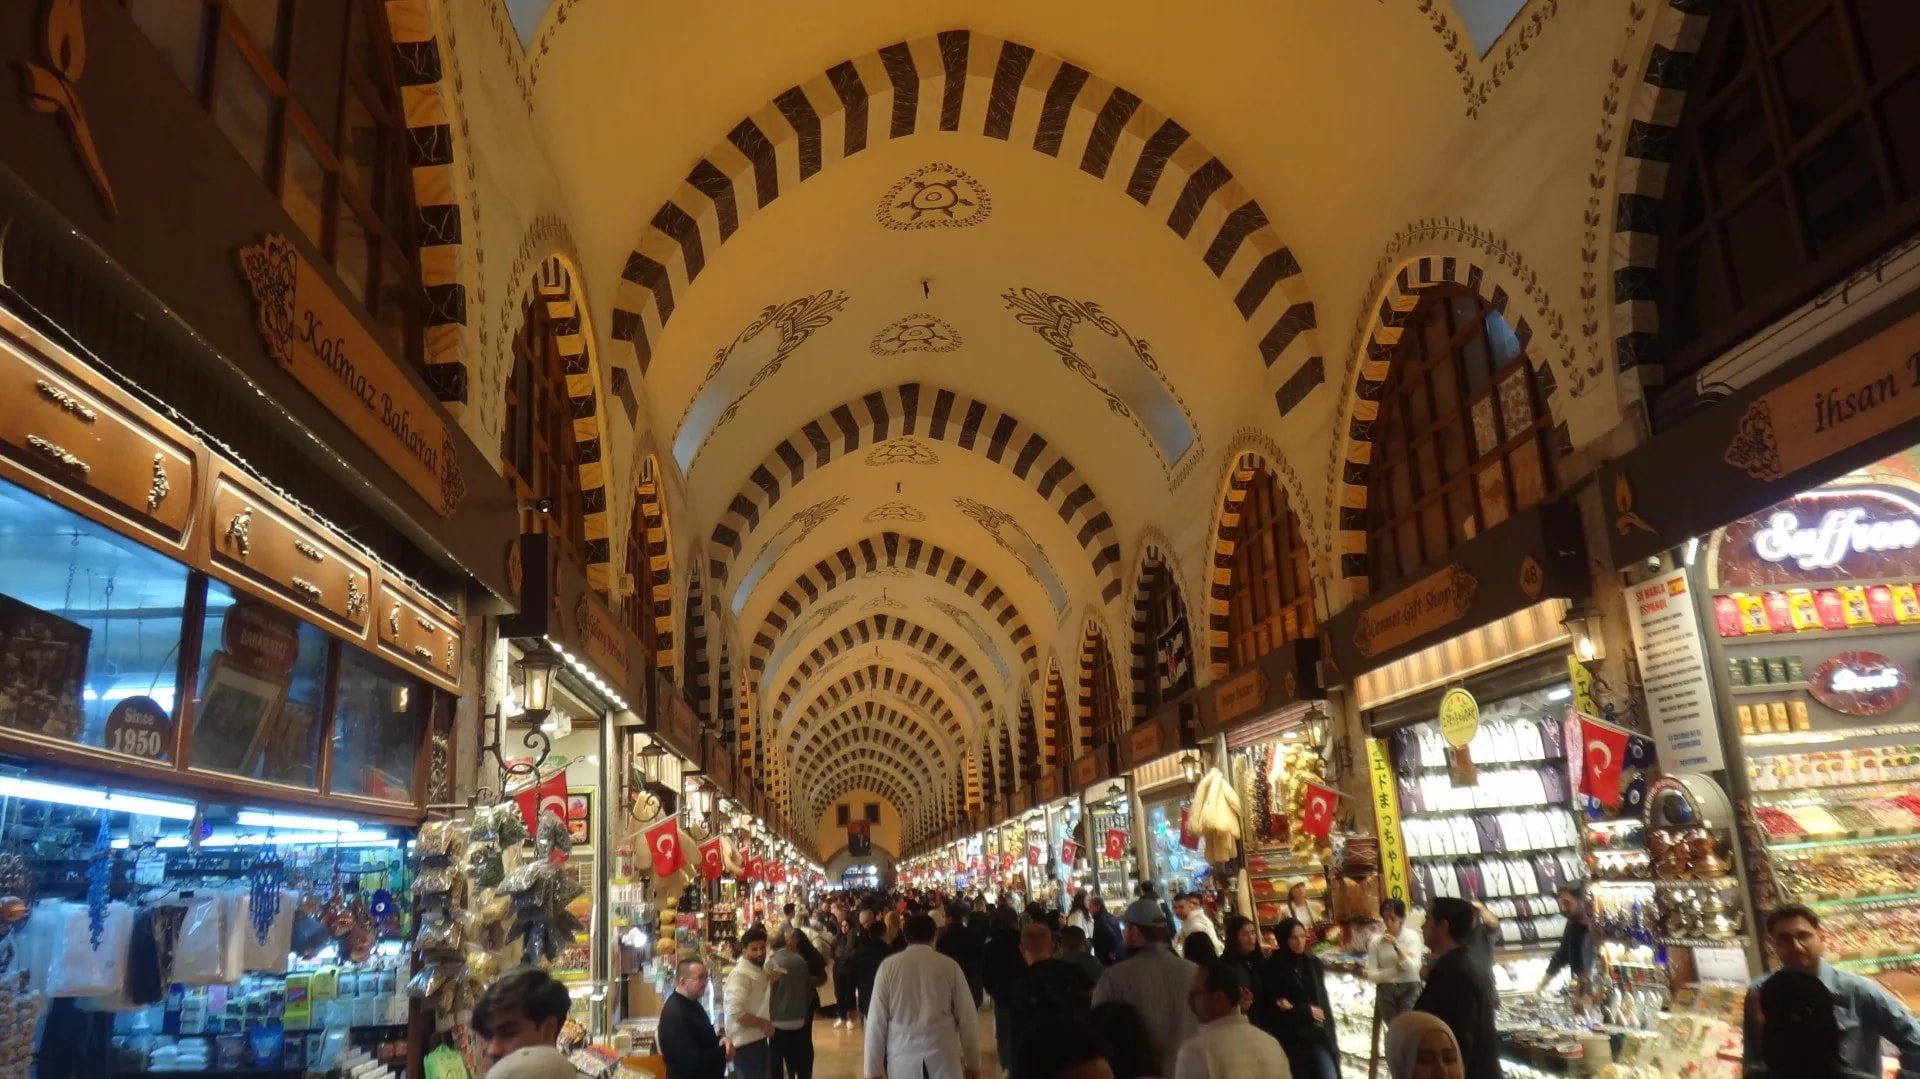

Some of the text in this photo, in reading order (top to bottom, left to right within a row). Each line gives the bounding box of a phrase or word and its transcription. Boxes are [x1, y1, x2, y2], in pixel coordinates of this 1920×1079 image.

[300, 309, 437, 476] Kalmaz Baharat
[1754, 507, 1920, 570] Saffron
[125, 707, 154, 726] Since
[112, 727, 161, 756] 1950
